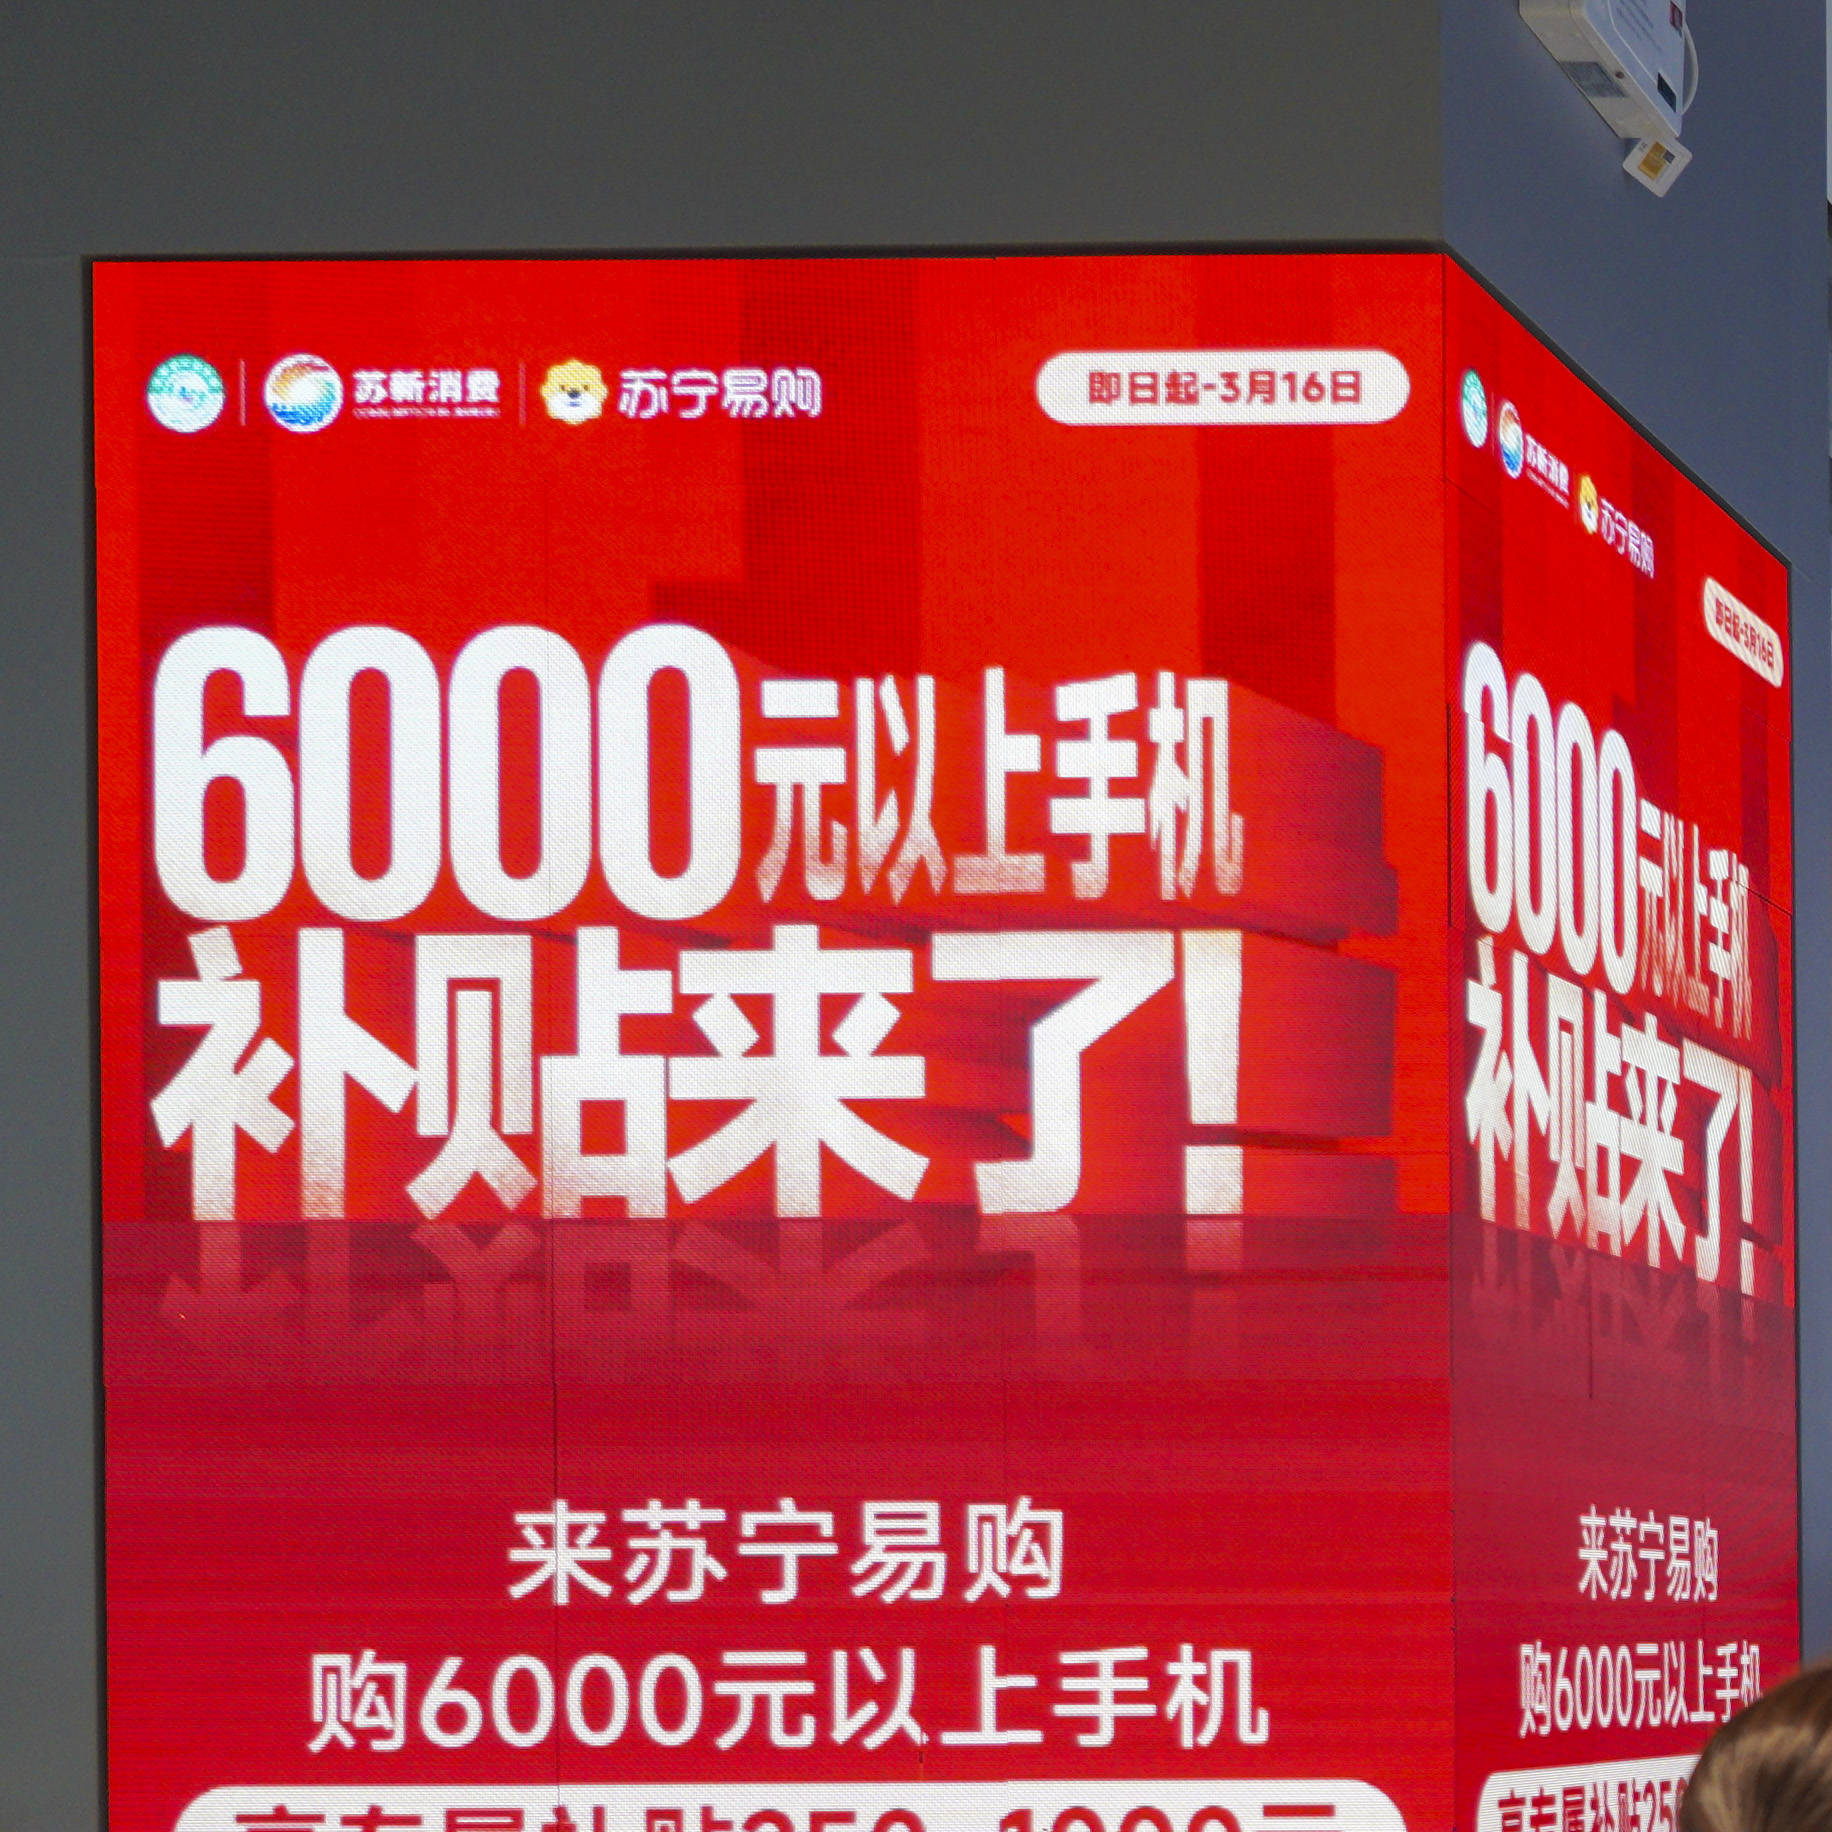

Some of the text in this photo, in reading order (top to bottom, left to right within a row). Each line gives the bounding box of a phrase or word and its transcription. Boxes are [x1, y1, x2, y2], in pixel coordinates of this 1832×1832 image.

[352, 368, 501, 405] 苏新消费
[617, 366, 823, 420] 苏宁易购
[1087, 368, 1364, 408] 即日起-3月16日
[150, 623, 1245, 922] 6000元以上手机
[1462, 641, 1753, 1041] 6000元以上手机
[505, 1496, 1068, 1606] 来苏宁易购
[1577, 1503, 1720, 1603] 来苏宁易购
[308, 1643, 1271, 1755] 购6000元以上手机
